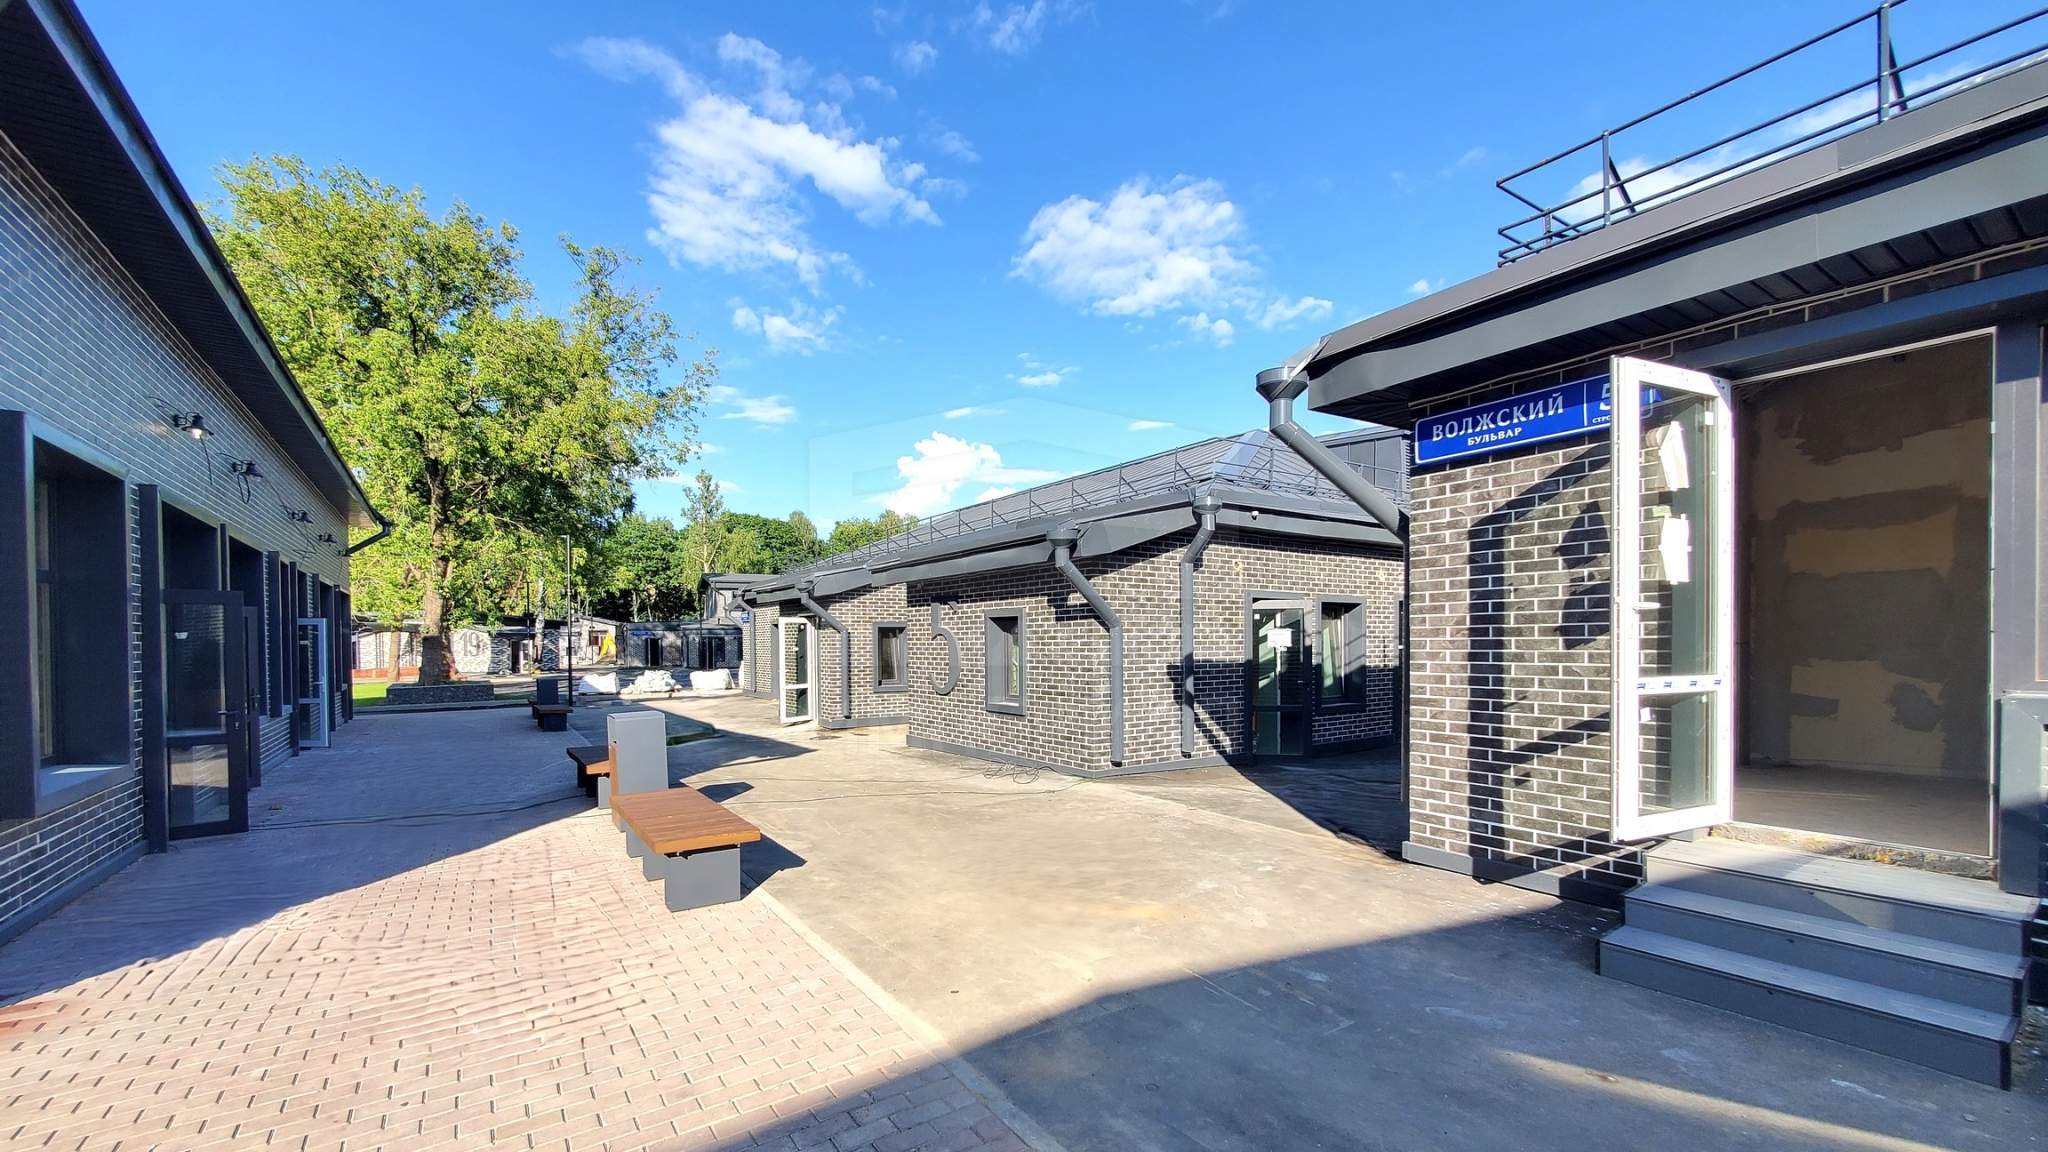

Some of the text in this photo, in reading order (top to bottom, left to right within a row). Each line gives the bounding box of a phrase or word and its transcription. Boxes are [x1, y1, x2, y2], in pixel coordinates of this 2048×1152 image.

[1431, 392, 1563, 442] ВОЛЖСКИЙ
[1467, 427, 1522, 446] БУЛЬВАР
[460, 631, 481, 657] 19
